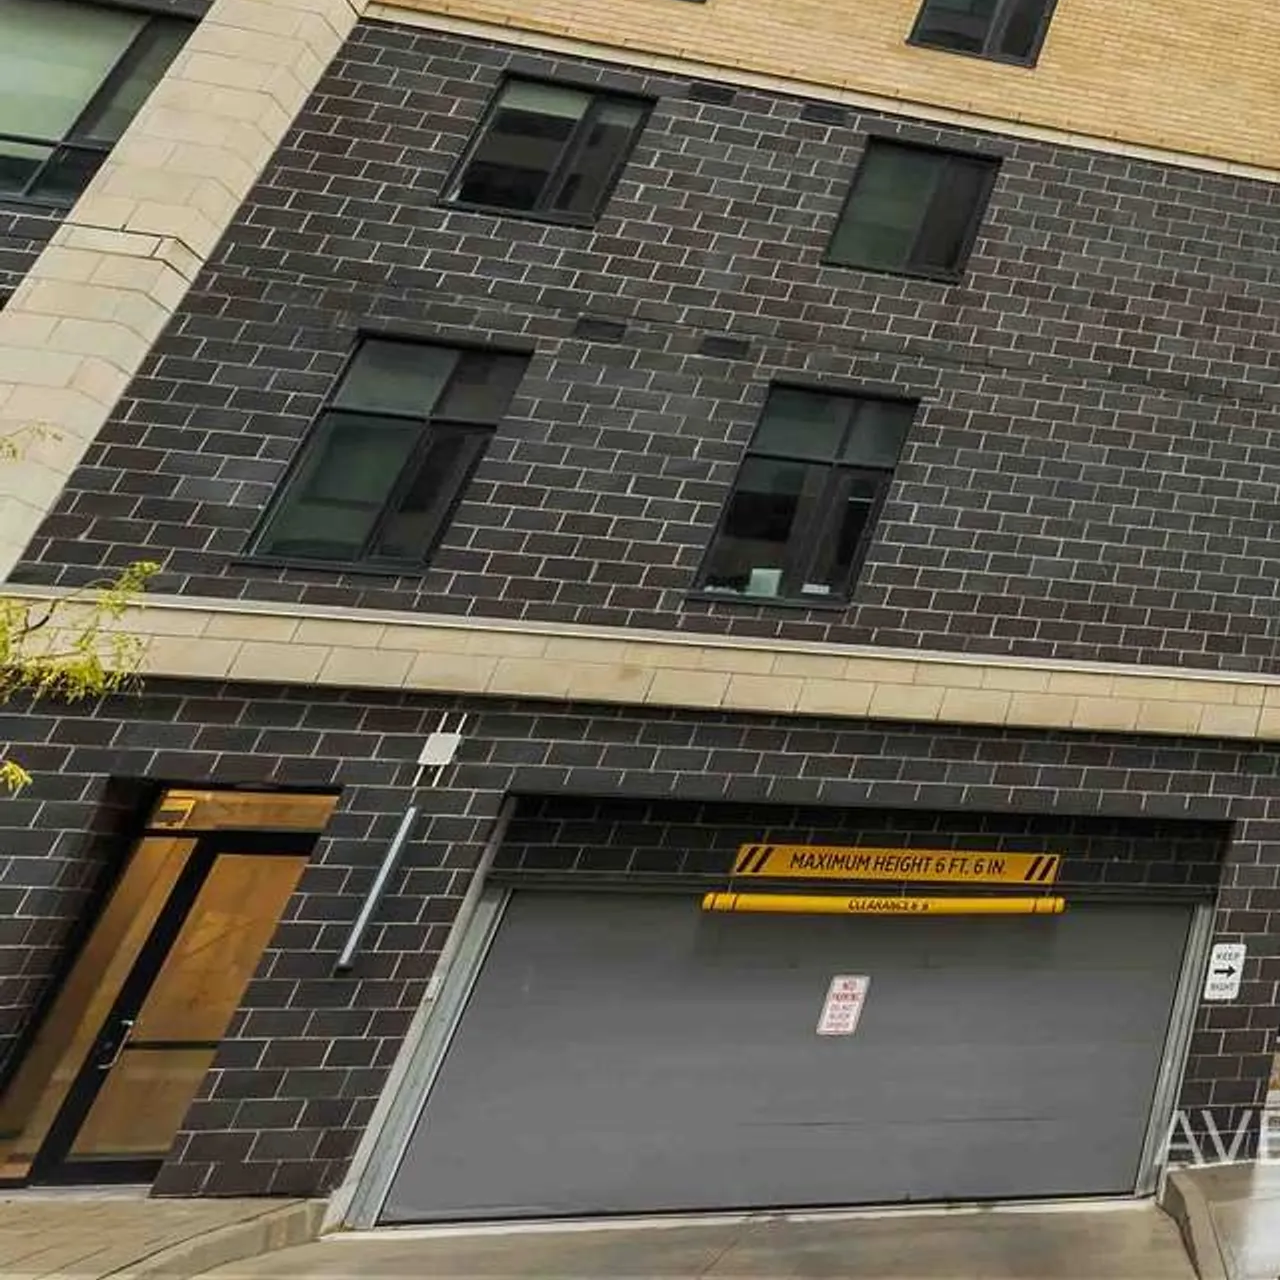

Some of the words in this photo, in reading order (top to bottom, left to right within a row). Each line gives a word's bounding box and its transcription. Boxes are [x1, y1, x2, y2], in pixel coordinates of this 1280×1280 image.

[790, 853, 871, 870] MAXIMUM
[873, 856, 933, 873] HEIGHT
[935, 857, 946, 872] 6
[948, 859, 970, 875] FT.
[973, 860, 984, 874] 6
